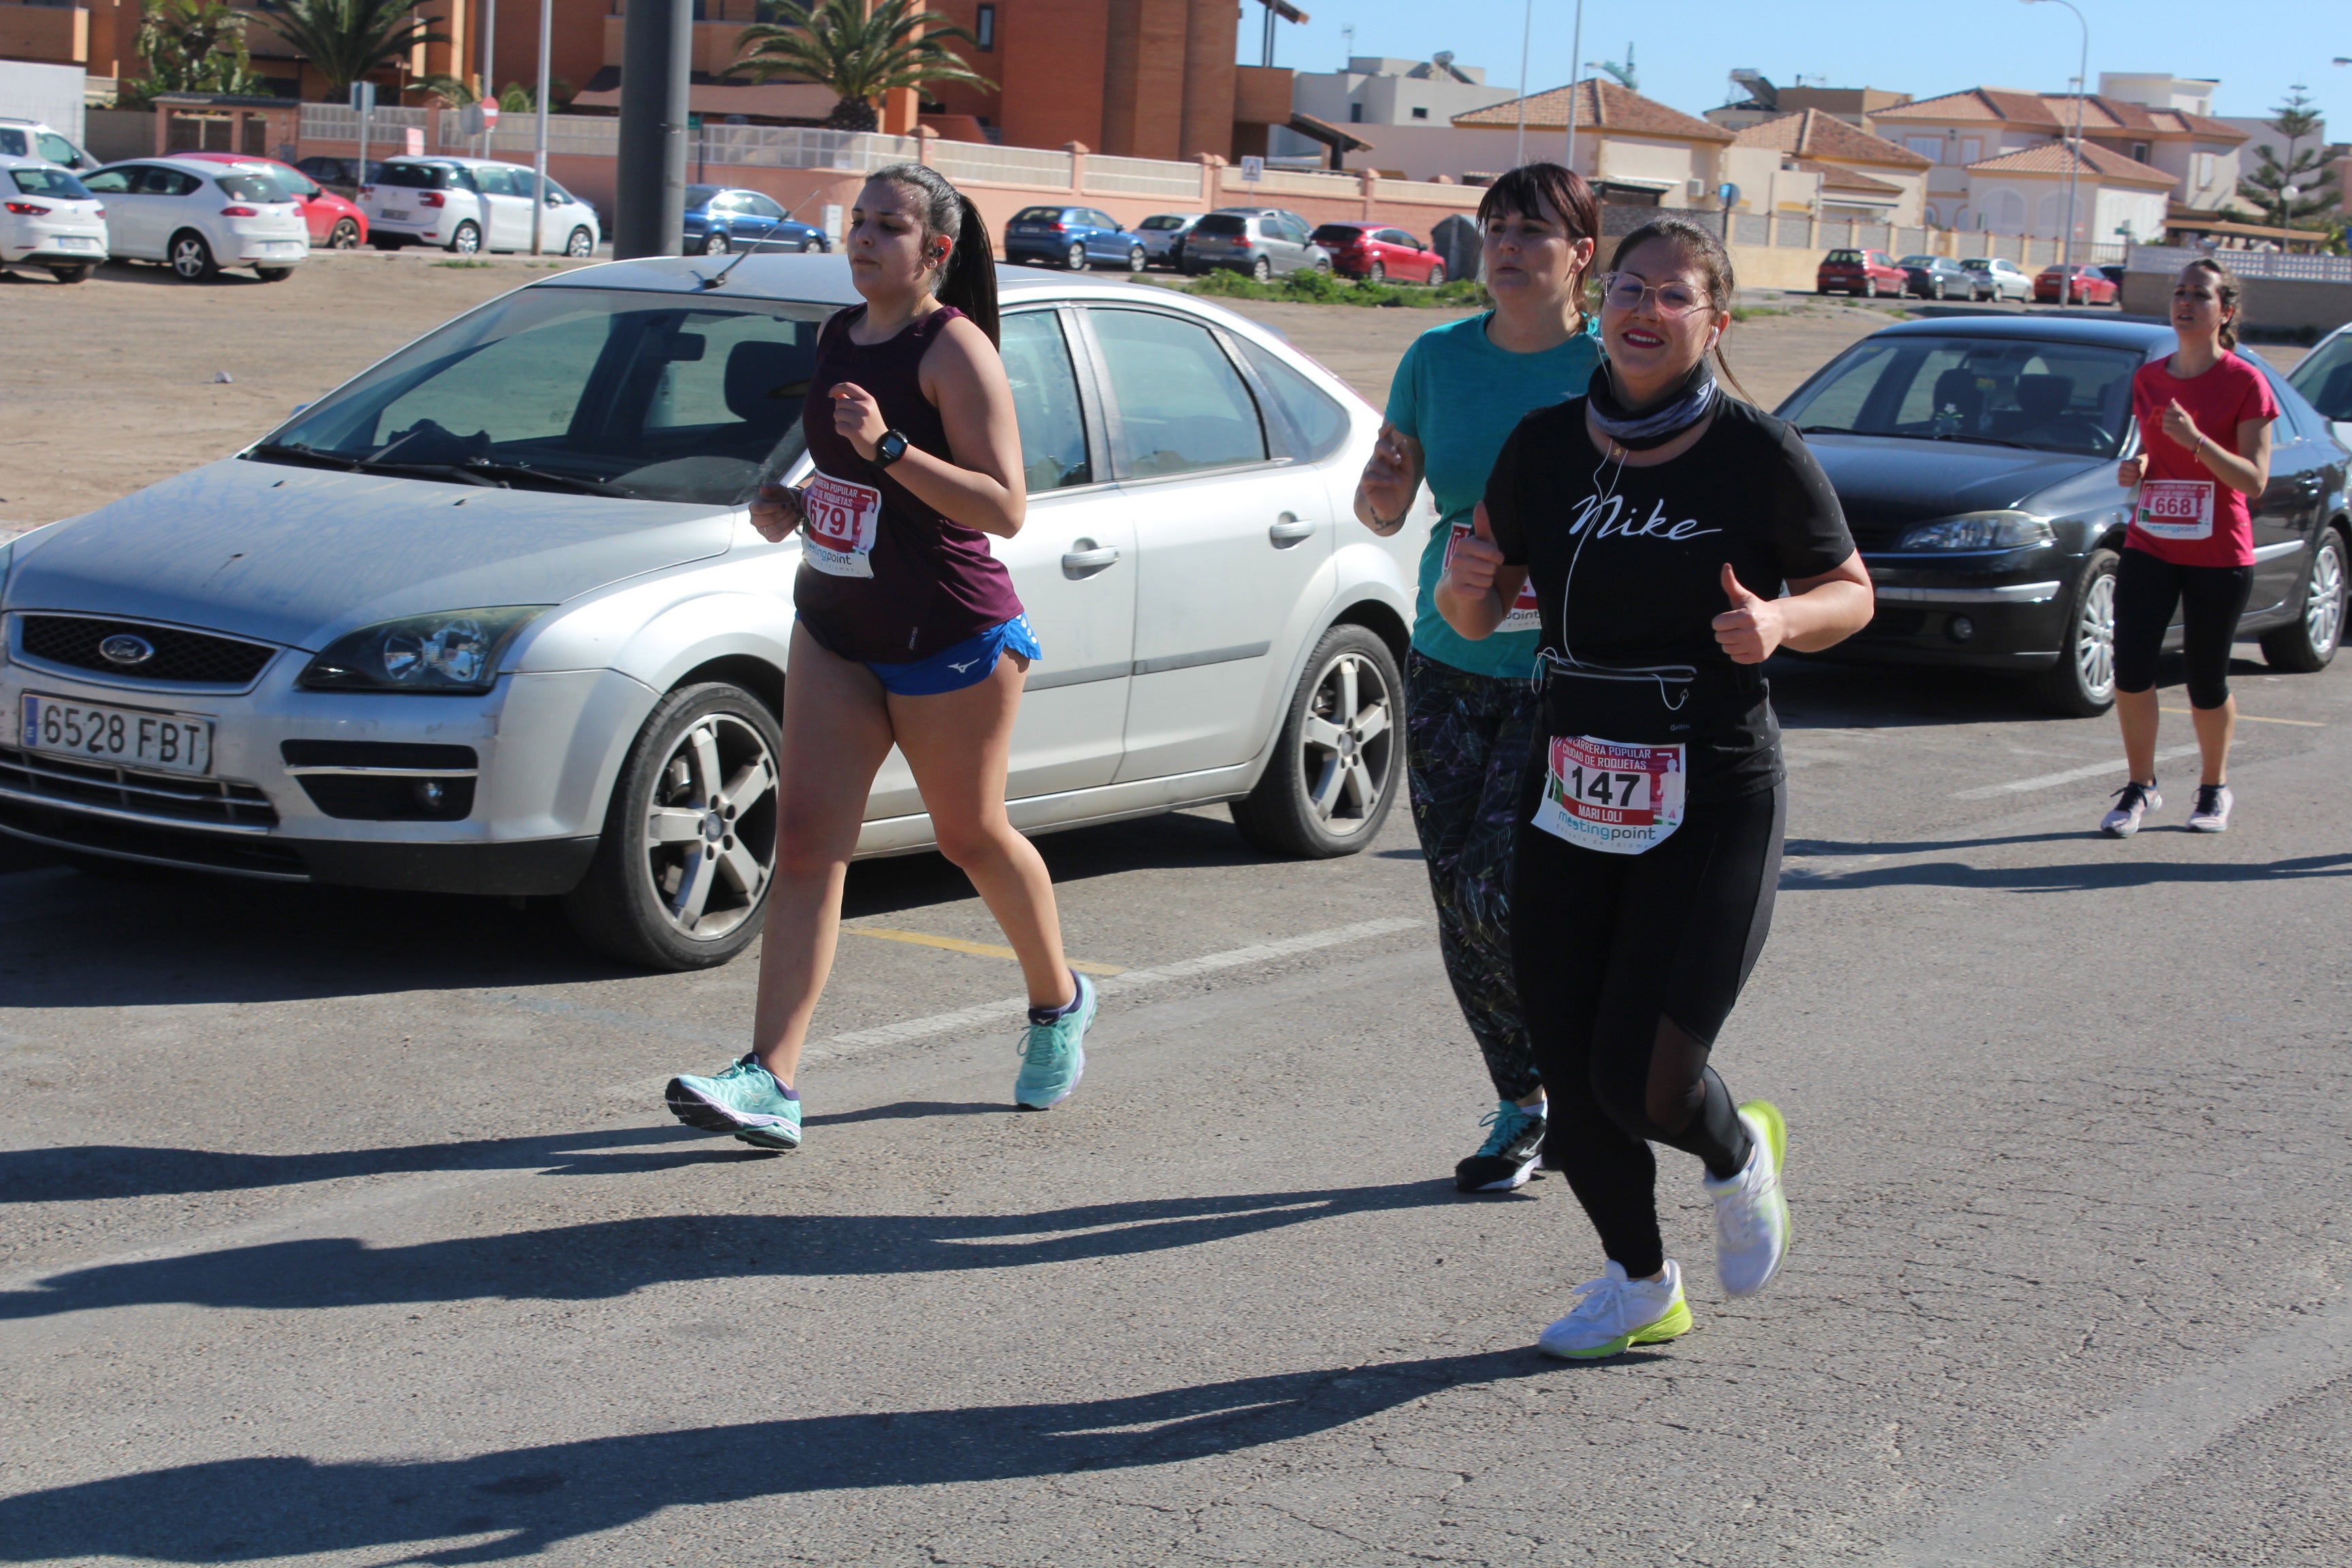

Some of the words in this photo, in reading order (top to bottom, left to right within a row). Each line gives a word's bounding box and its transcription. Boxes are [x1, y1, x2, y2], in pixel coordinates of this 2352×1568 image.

[823, 491, 853, 507] ROQUETAS
[830, 483, 858, 498] POPULAR
[809, 498, 846, 536] 679
[1569, 495, 1722, 540] Nike
[2155, 497, 2192, 515] 668
[44, 704, 125, 754] 6528
[137, 717, 201, 766] FBT
[1562, 743, 1584, 762] CIUDAD
[1584, 755, 1596, 766] DE
[1597, 757, 1647, 770] ROQUETAS
[1573, 738, 1606, 755] CARRERA
[1608, 746, 1651, 759] POPULAR
[1571, 766, 1640, 807] 147
[1578, 804, 1600, 820] MARI
[1601, 809, 1622, 823] LOLI
